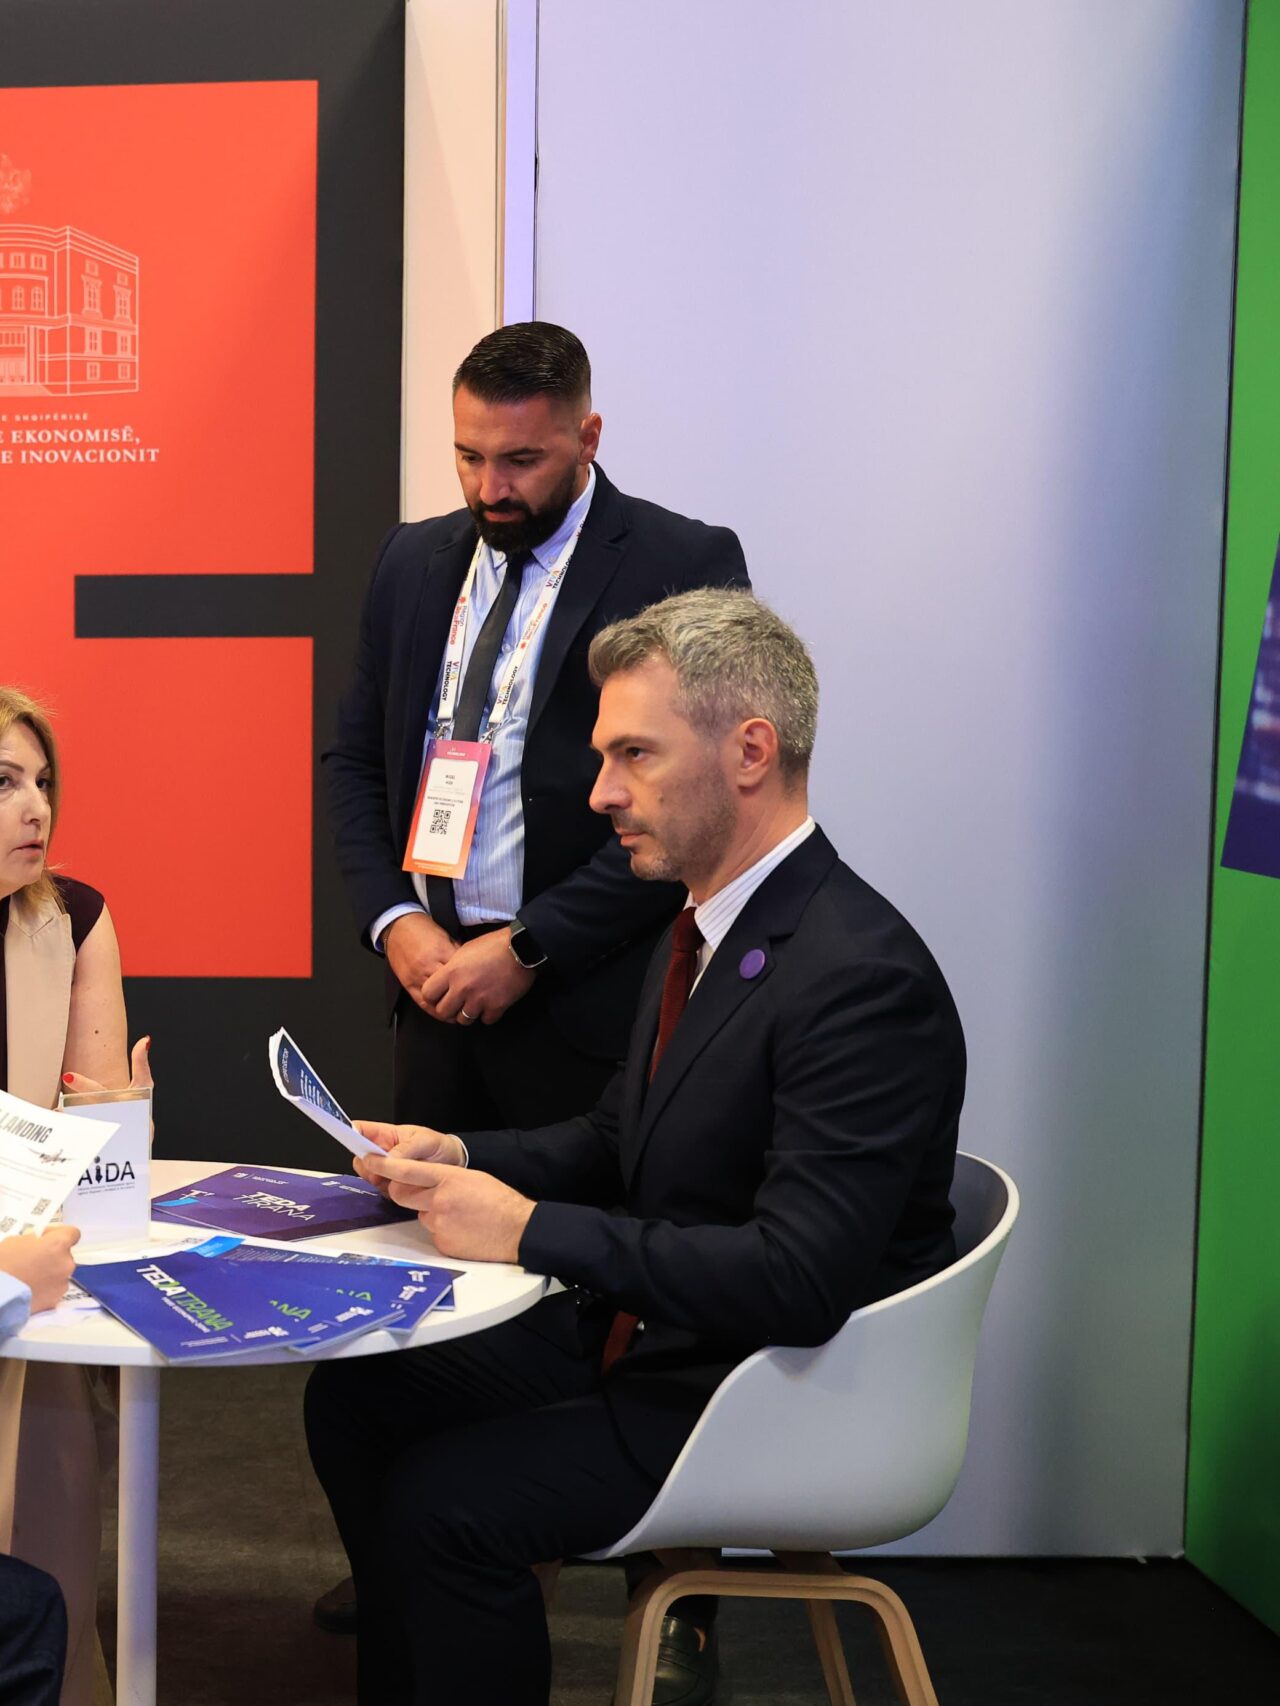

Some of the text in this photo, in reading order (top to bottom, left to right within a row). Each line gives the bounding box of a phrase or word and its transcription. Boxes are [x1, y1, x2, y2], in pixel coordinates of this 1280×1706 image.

[1, 414, 8, 422] E
[20, 447, 160, 464] INOVACIONIT
[552, 554, 573, 590] TECHNOLO
[441, 660, 452, 702] TECHNOLOGY
[232, 1194, 317, 1222] TIRANA
[248, 1191, 311, 1212] TEDA
[136, 1264, 187, 1297] TEDA
